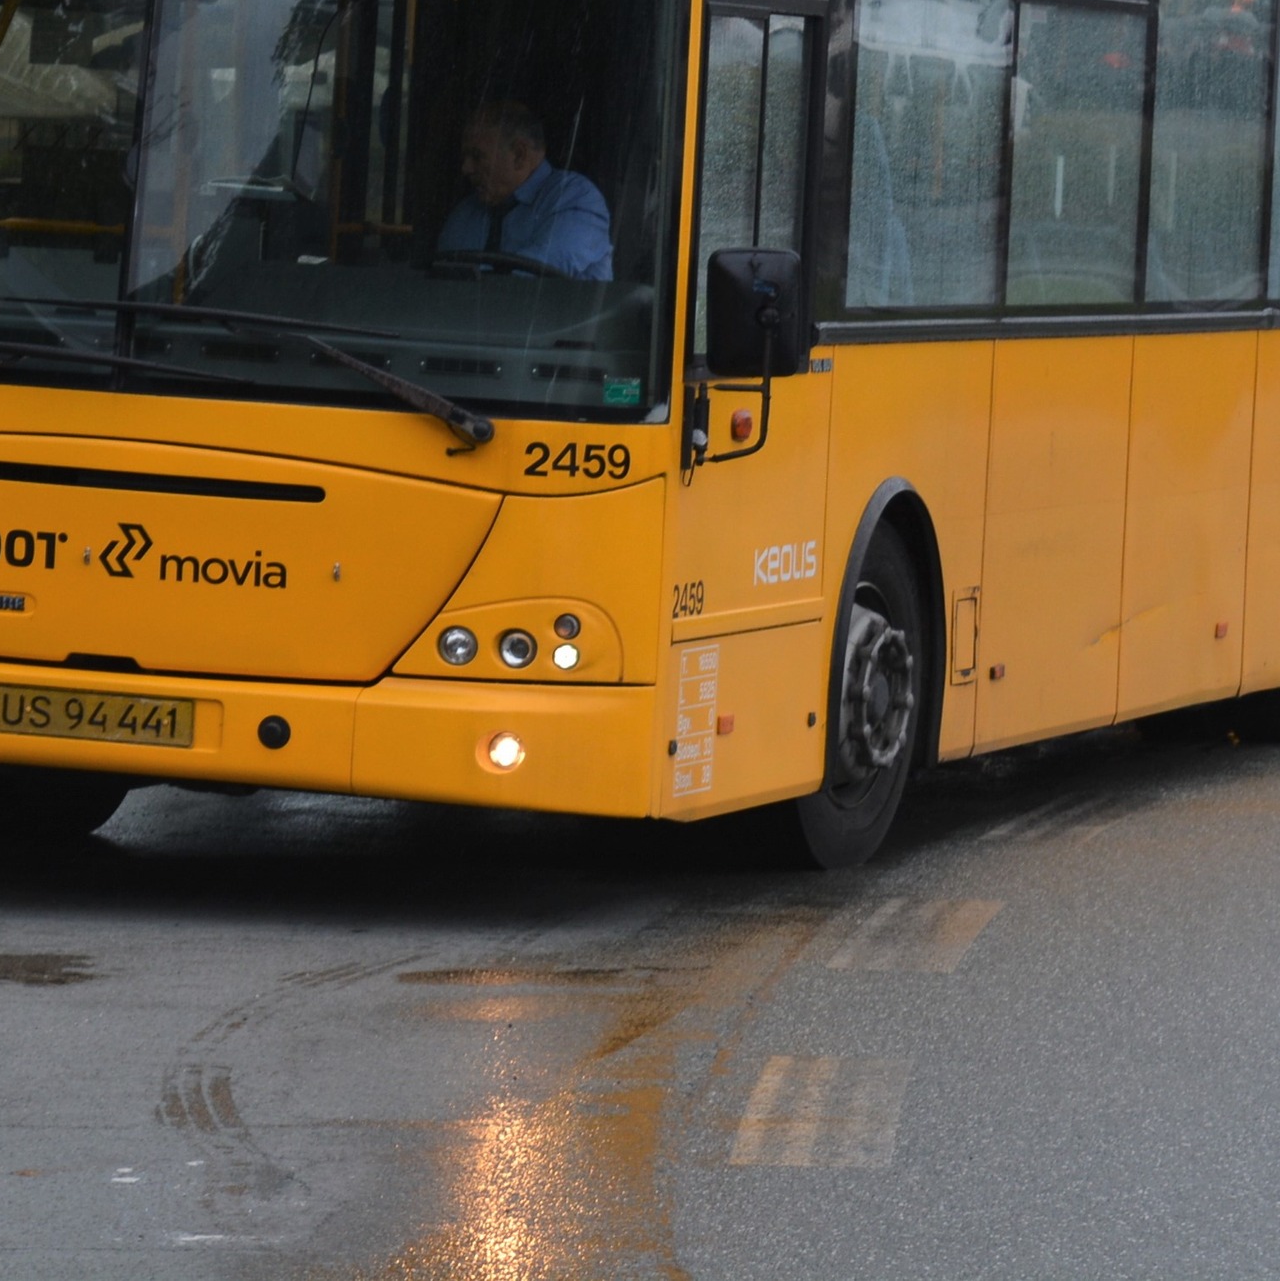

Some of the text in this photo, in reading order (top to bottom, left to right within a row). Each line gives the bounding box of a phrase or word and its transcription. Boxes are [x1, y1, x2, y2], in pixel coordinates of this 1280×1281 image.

[524, 442, 631, 480] 2459
[159, 550, 287, 589] movia
[672, 580, 704, 619] 2459
[2, 693, 177, 738] US 94 441
